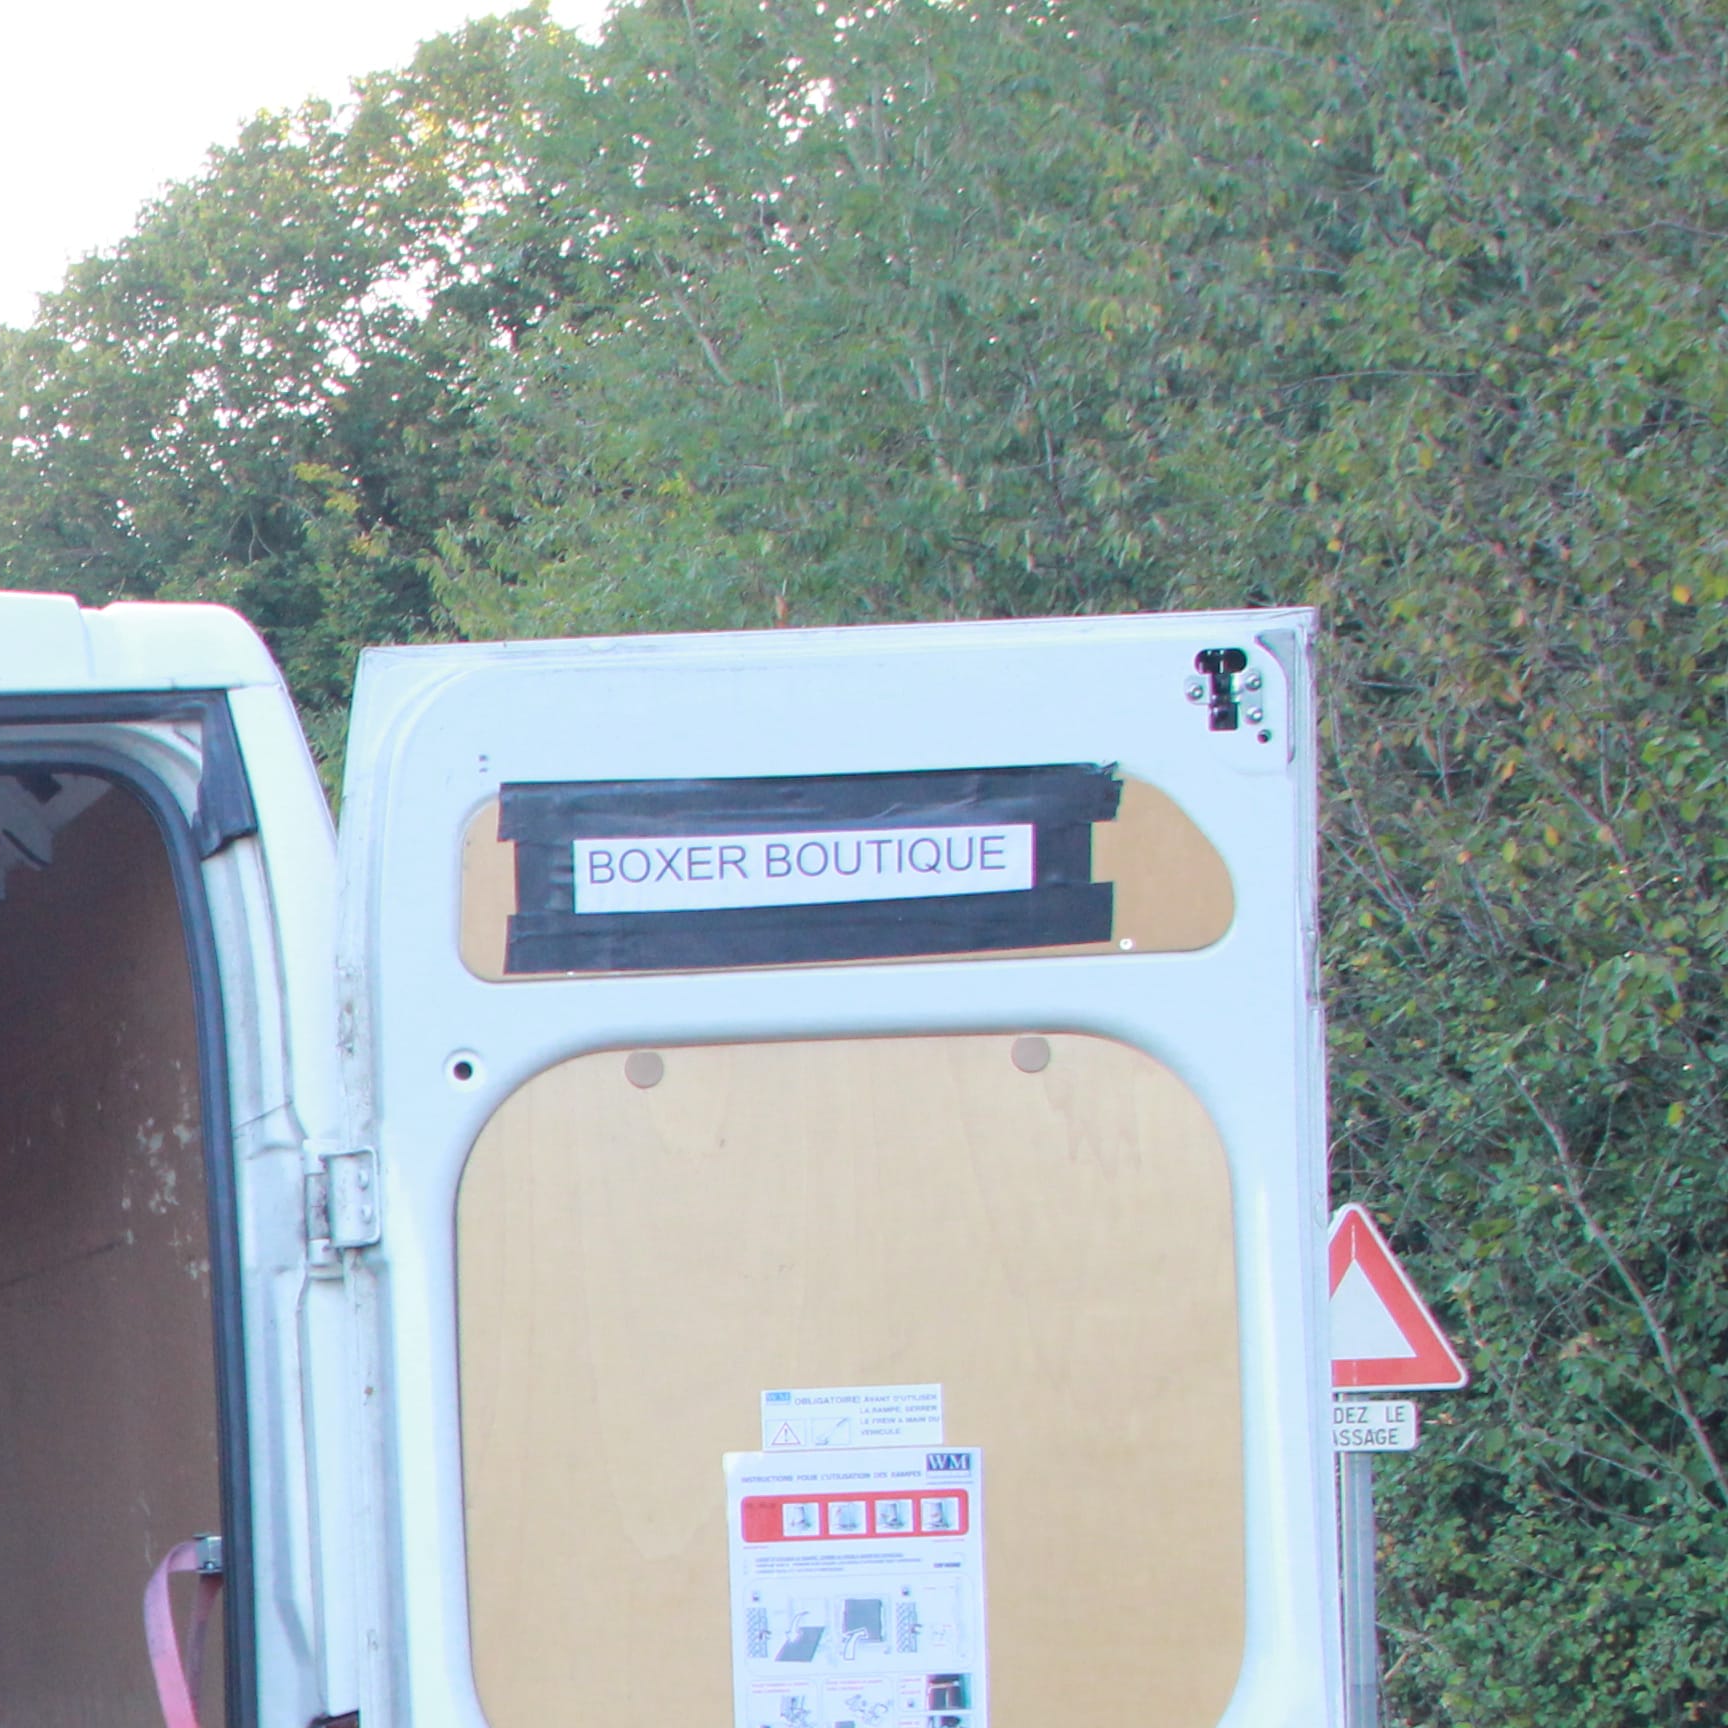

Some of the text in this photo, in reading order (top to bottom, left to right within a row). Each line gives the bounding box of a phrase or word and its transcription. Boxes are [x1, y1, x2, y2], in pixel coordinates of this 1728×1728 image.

[588, 835, 1007, 884] BOXER BOUTIQUE
[1386, 1406, 1405, 1423] LE
[928, 1454, 970, 1471] WM
